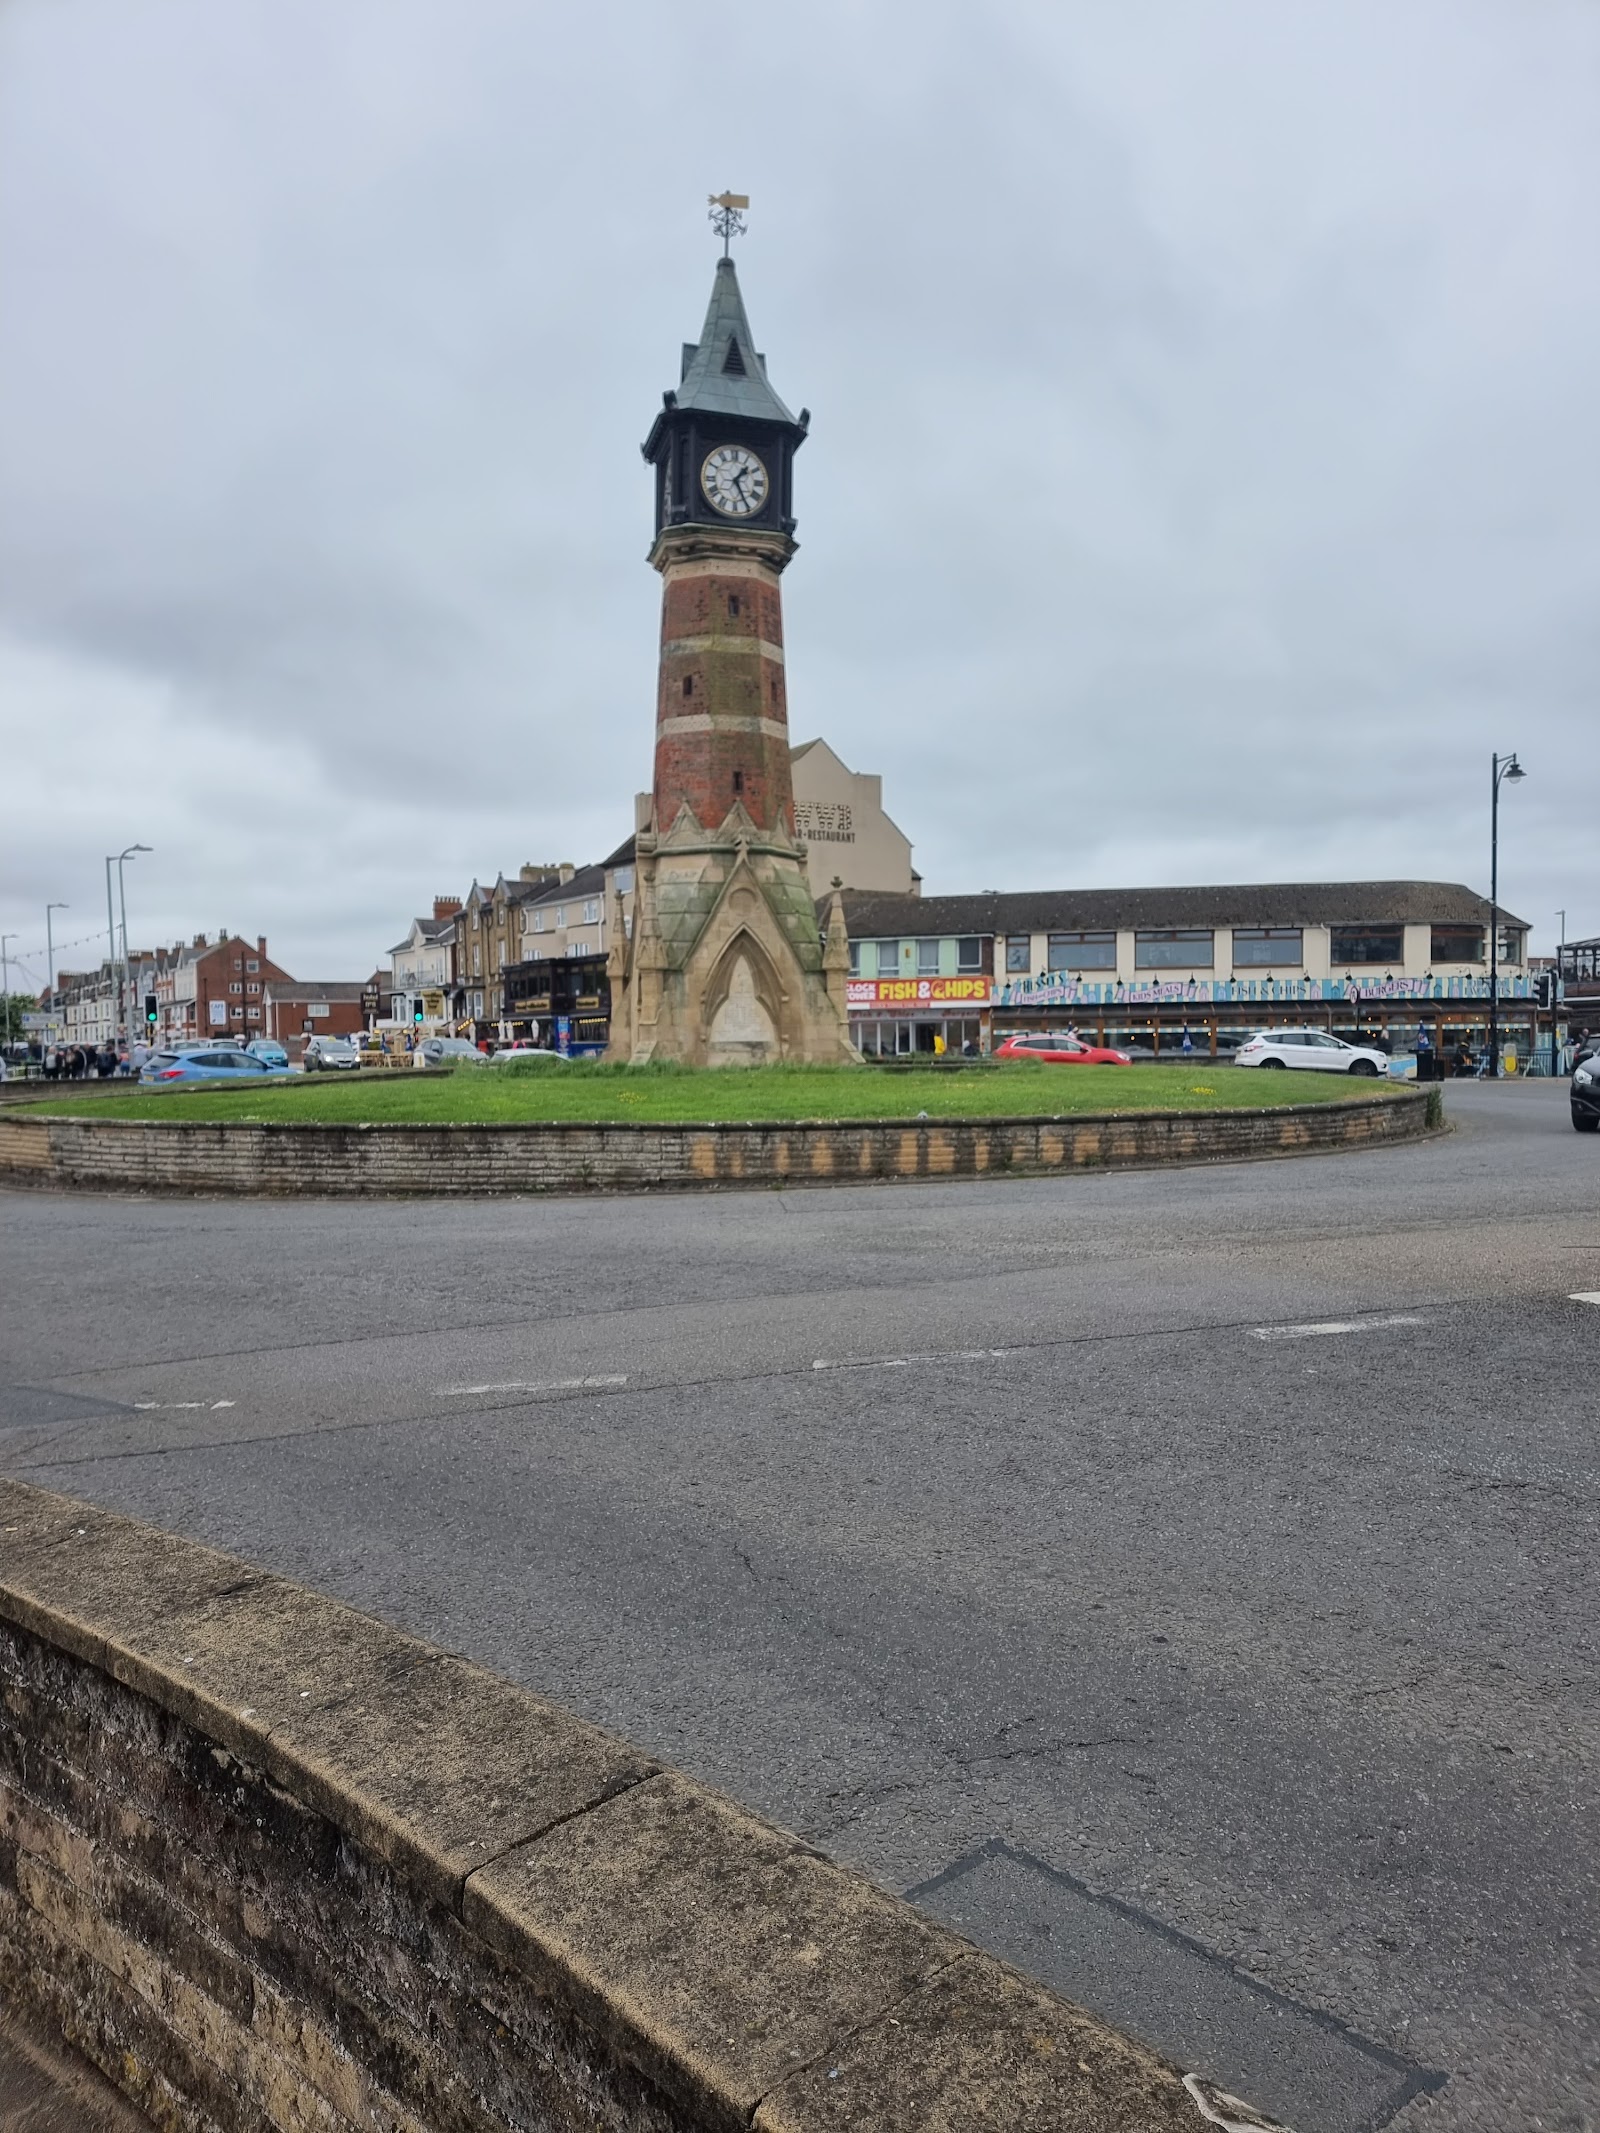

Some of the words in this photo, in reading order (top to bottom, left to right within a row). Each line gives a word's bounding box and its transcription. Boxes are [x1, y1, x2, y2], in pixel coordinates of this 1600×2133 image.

[808, 829, 855, 844] RESTAURANT
[847, 983, 876, 993] CLOCK
[879, 981, 917, 1000] FISH
[918, 980, 931, 999] &
[930, 979, 985, 999] CHIPS
[1132, 991, 1151, 1001] KIDS
[1153, 985, 1180, 998] MEALS
[1231, 986, 1257, 995] FISH
[1271, 985, 1307, 994] CHIPS
[1364, 982, 1410, 998] BURGERS
